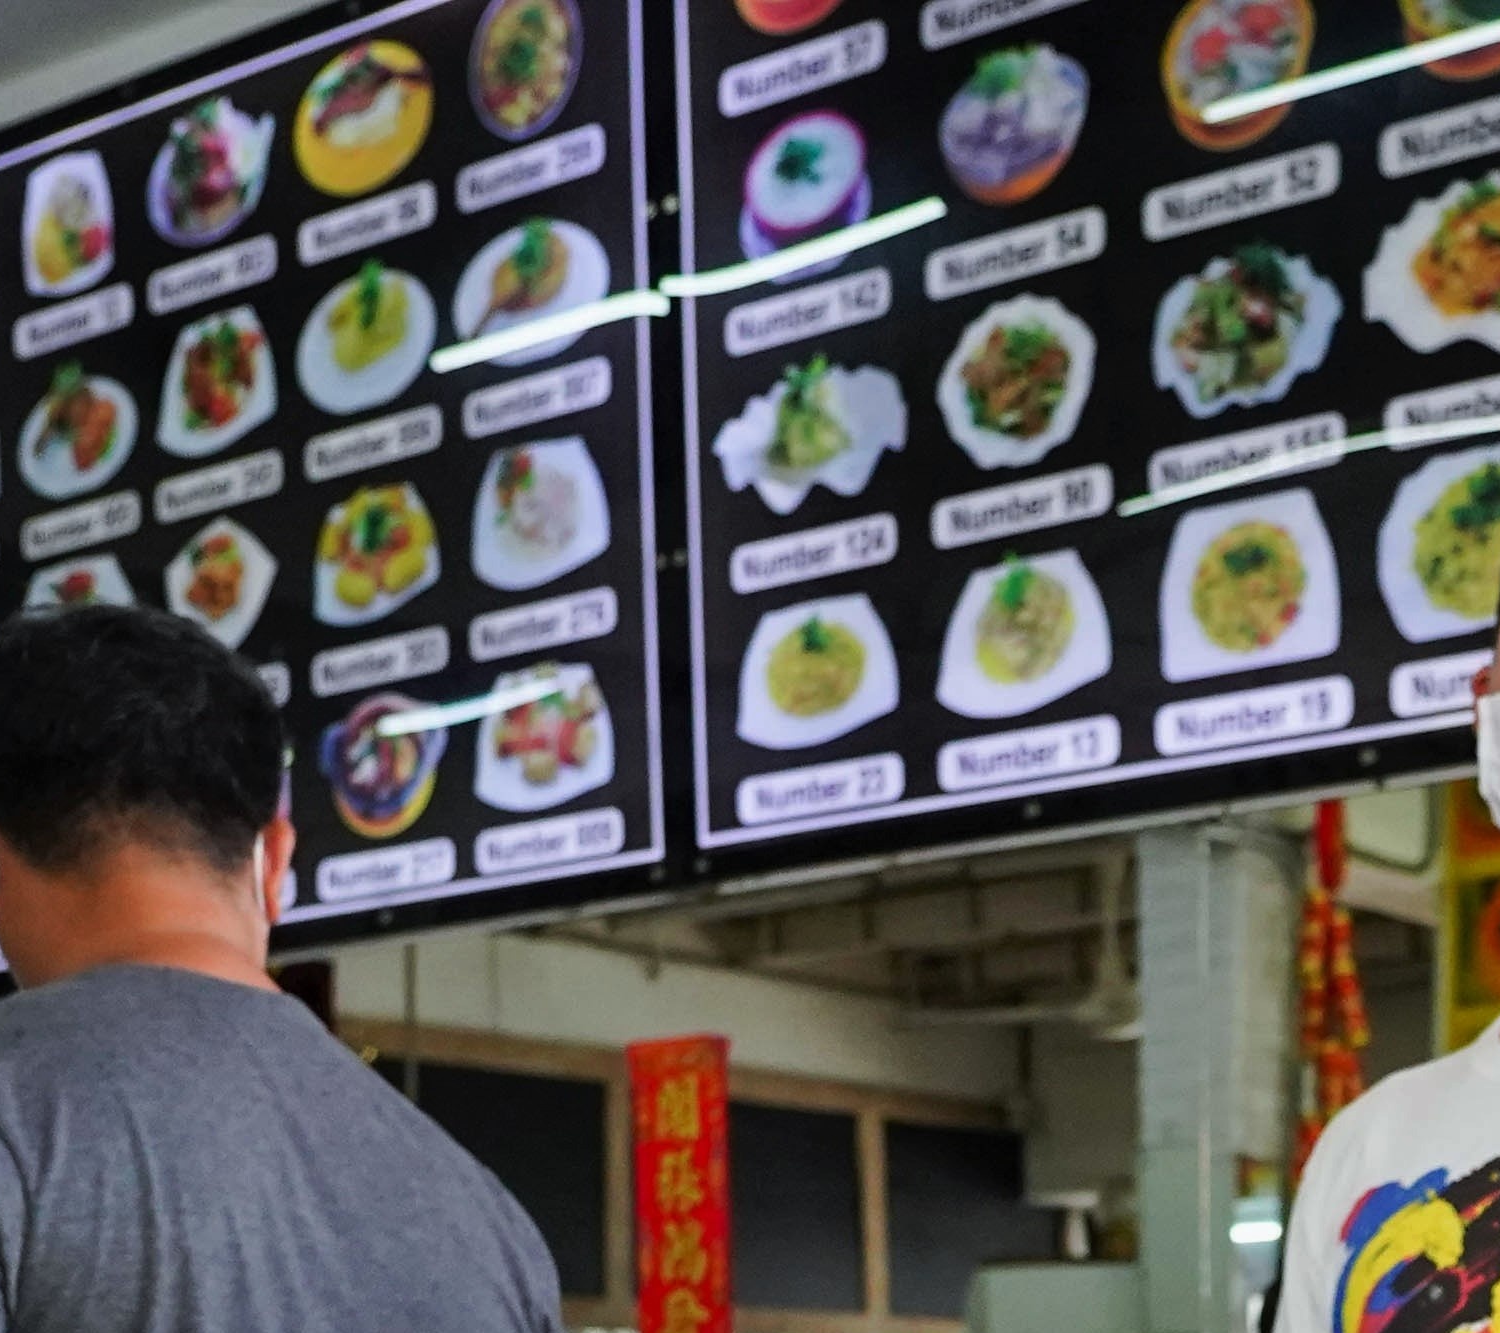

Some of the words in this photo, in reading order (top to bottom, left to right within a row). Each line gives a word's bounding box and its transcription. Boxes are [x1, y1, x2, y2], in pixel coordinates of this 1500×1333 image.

[733, 53, 832, 99] Number
[1161, 175, 1276, 223] Number
[942, 240, 1047, 283] Number
[735, 301, 829, 341] Number
[1159, 443, 1273, 486] Number
[948, 493, 1054, 533] Number
[741, 543, 836, 579] Number
[479, 614, 561, 648] Number
[1174, 703, 1288, 740] Number
[955, 741, 1060, 777] Number
[754, 778, 849, 810] Number
[485, 831, 567, 862] Number
